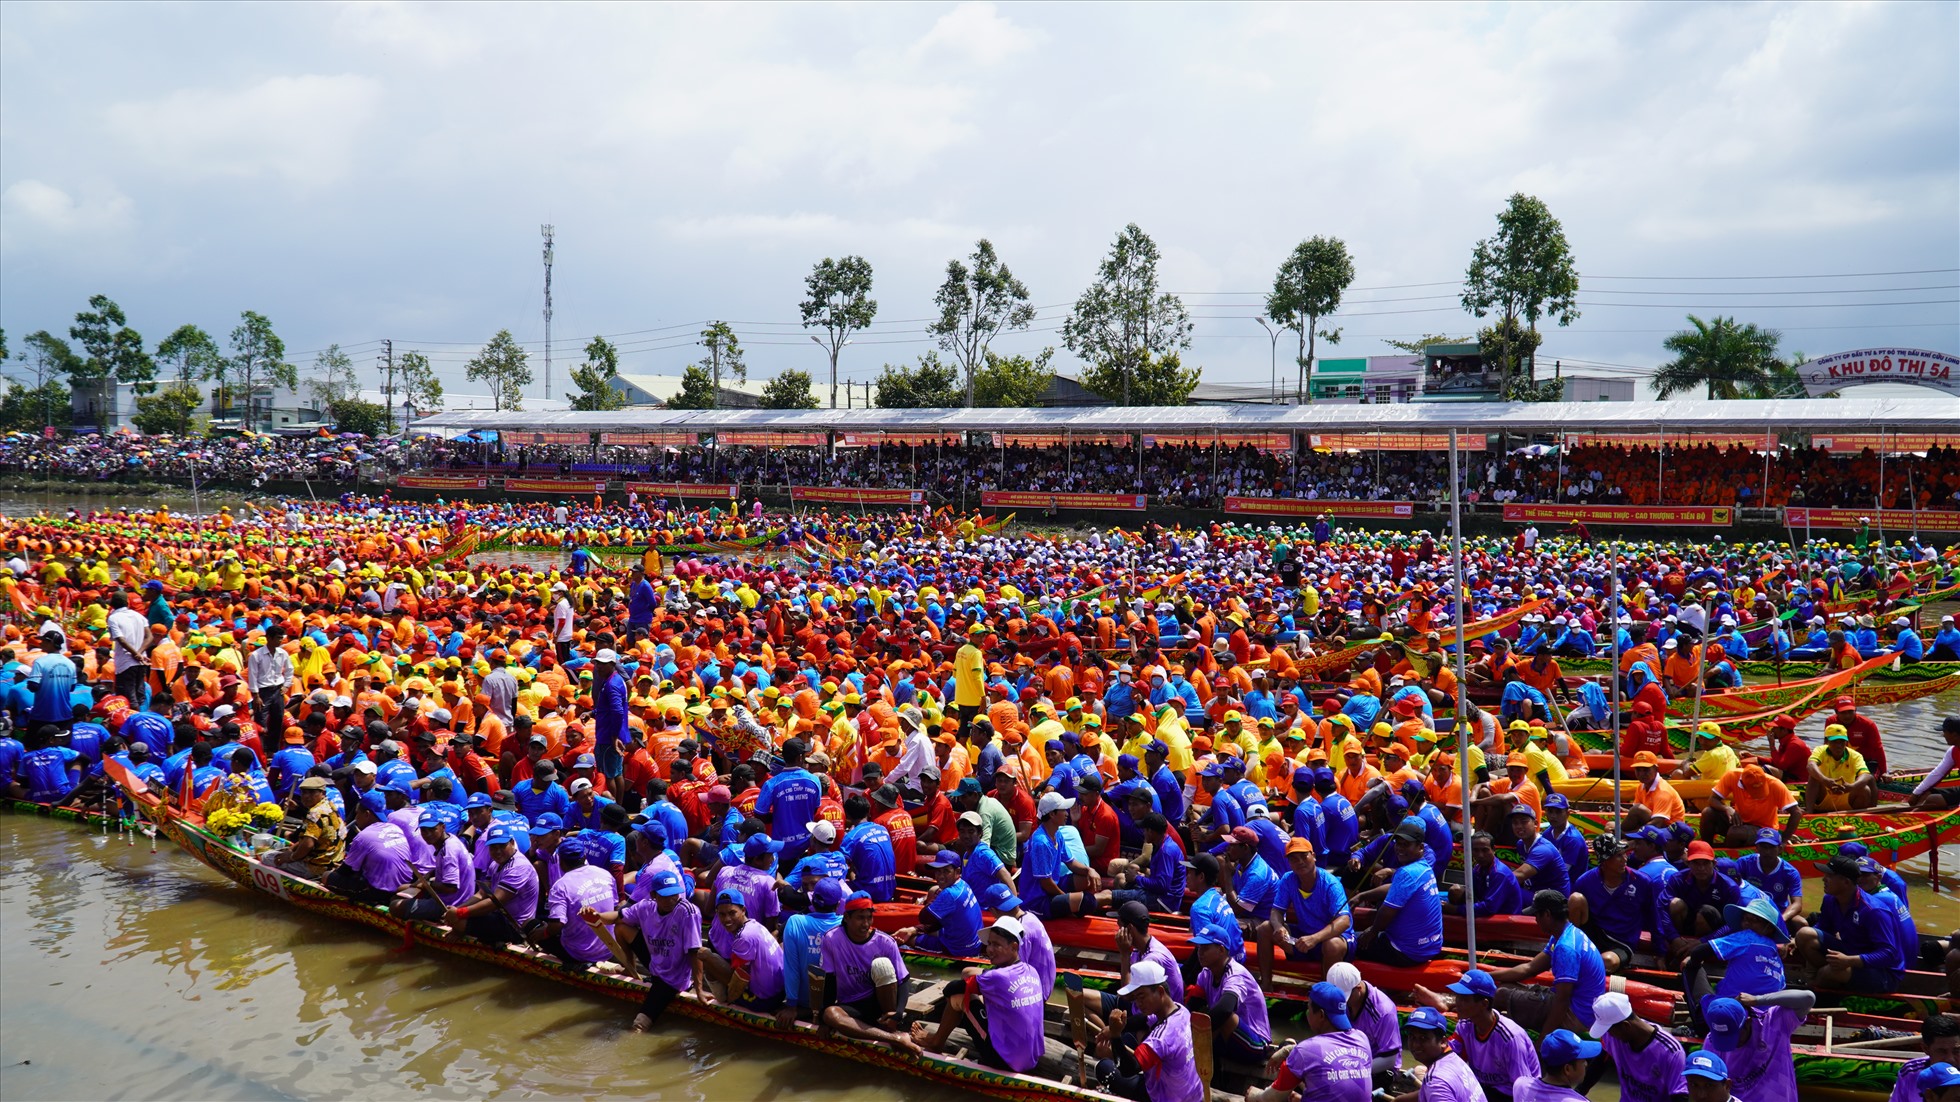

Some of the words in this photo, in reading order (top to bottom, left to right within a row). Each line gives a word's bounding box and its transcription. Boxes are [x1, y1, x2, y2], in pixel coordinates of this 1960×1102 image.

[1818, 358, 1834, 366] CÔNG
[1944, 356, 1960, 365] LONG
[1828, 360, 1864, 379] KHU
[1869, 355, 1892, 372] ĐÔ
[1898, 358, 1926, 378] THỊ
[1930, 362, 1950, 380] 5A
[1614, 512, 1630, 520] THỰC
[1650, 512, 1674, 520] THƯỢNG
[1681, 510, 1695, 519] TIẾN
[1696, 512, 1706, 521] BỘ
[891, 818, 902, 830] TRÍ
[254, 869, 280, 894] 09
[647, 935, 675, 948] Emirates
[1011, 997, 1021, 1010] ĐỘI
[1327, 1068, 1338, 1082] ĐỘI
[1338, 1070, 1349, 1080] GHE
